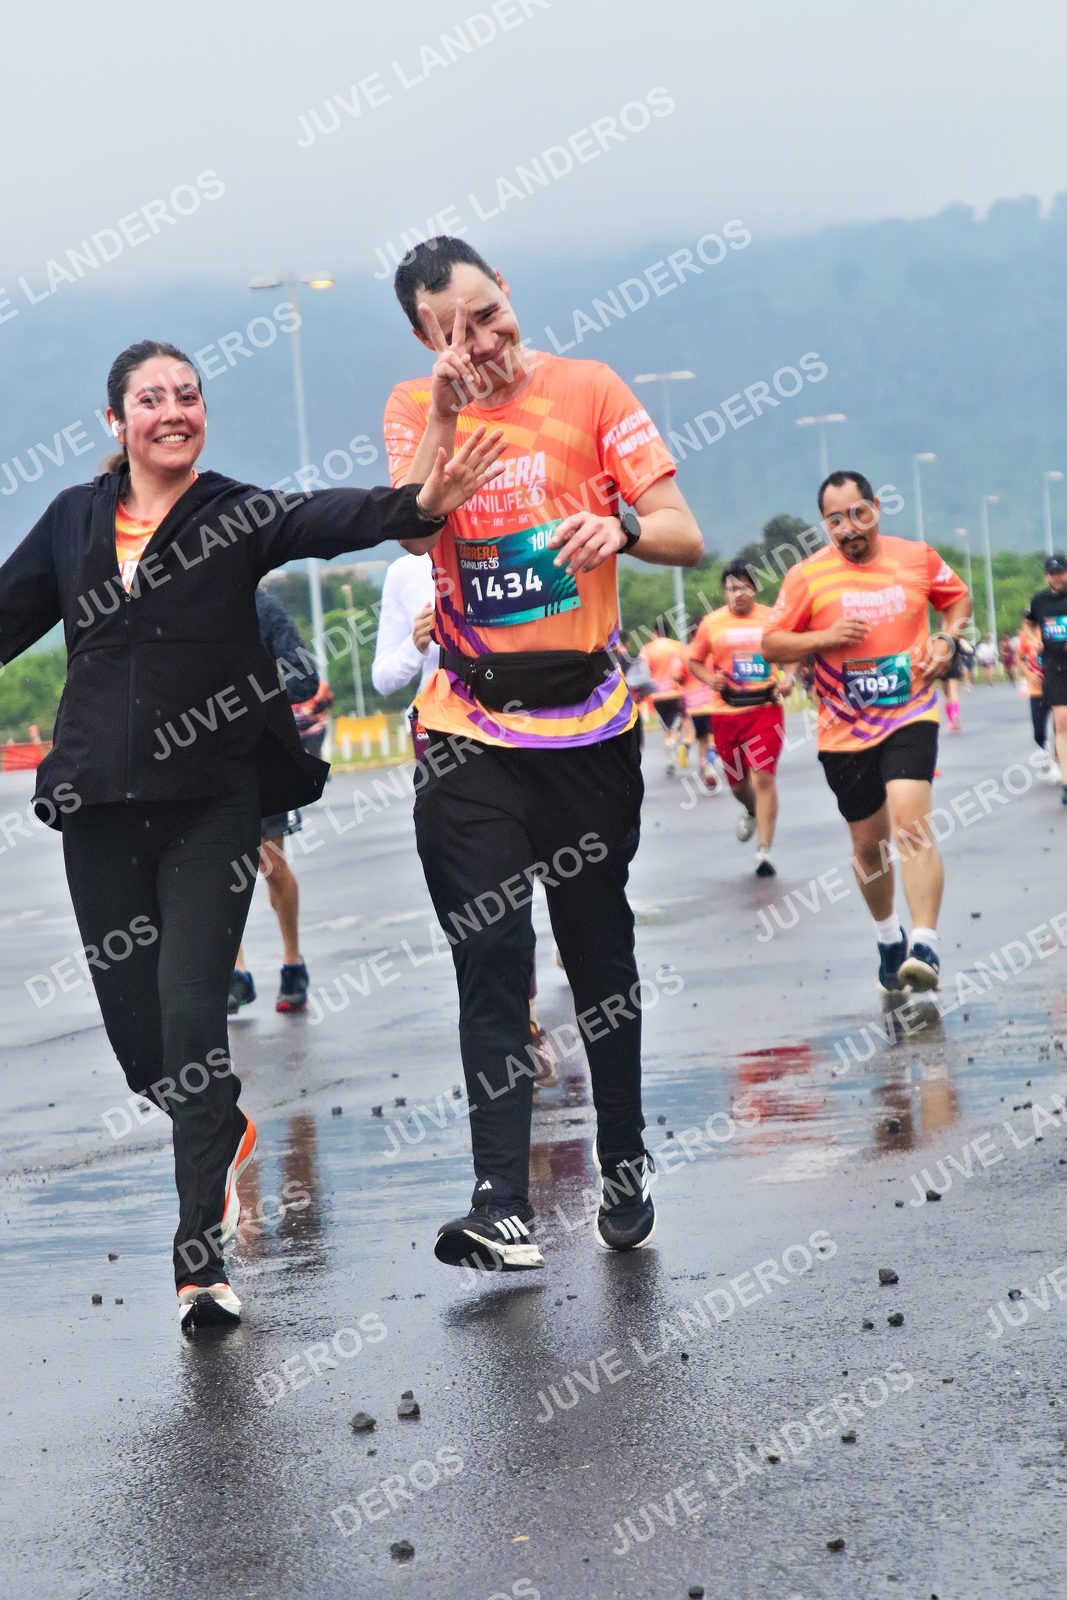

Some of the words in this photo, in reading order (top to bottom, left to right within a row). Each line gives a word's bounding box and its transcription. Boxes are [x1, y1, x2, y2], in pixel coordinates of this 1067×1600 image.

[482, 451, 546, 490] RERA
[458, 491, 525, 513] MNILIFE
[531, 529, 553, 552] 10K
[472, 567, 543, 601] 1434
[857, 674, 898, 693] 1097
